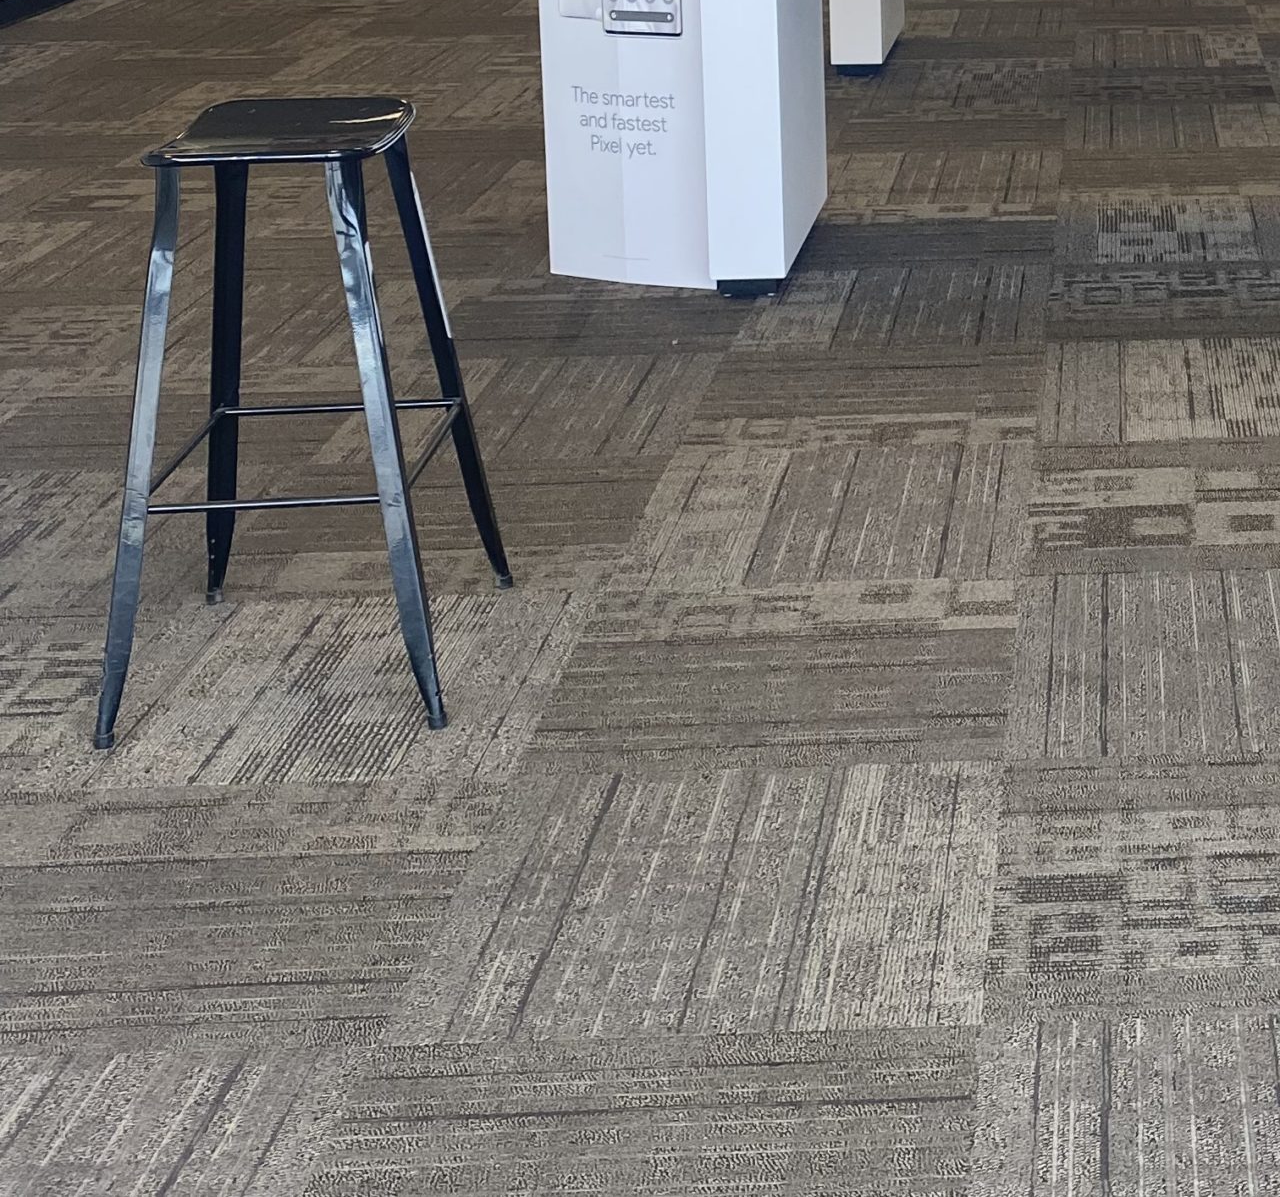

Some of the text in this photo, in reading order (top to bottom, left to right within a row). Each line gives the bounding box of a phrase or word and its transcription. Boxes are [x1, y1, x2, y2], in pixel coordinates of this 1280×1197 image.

[571, 85, 676, 109] The smartest
[580, 112, 667, 133] and fastest
[591, 134, 657, 159] Pixel yet.
